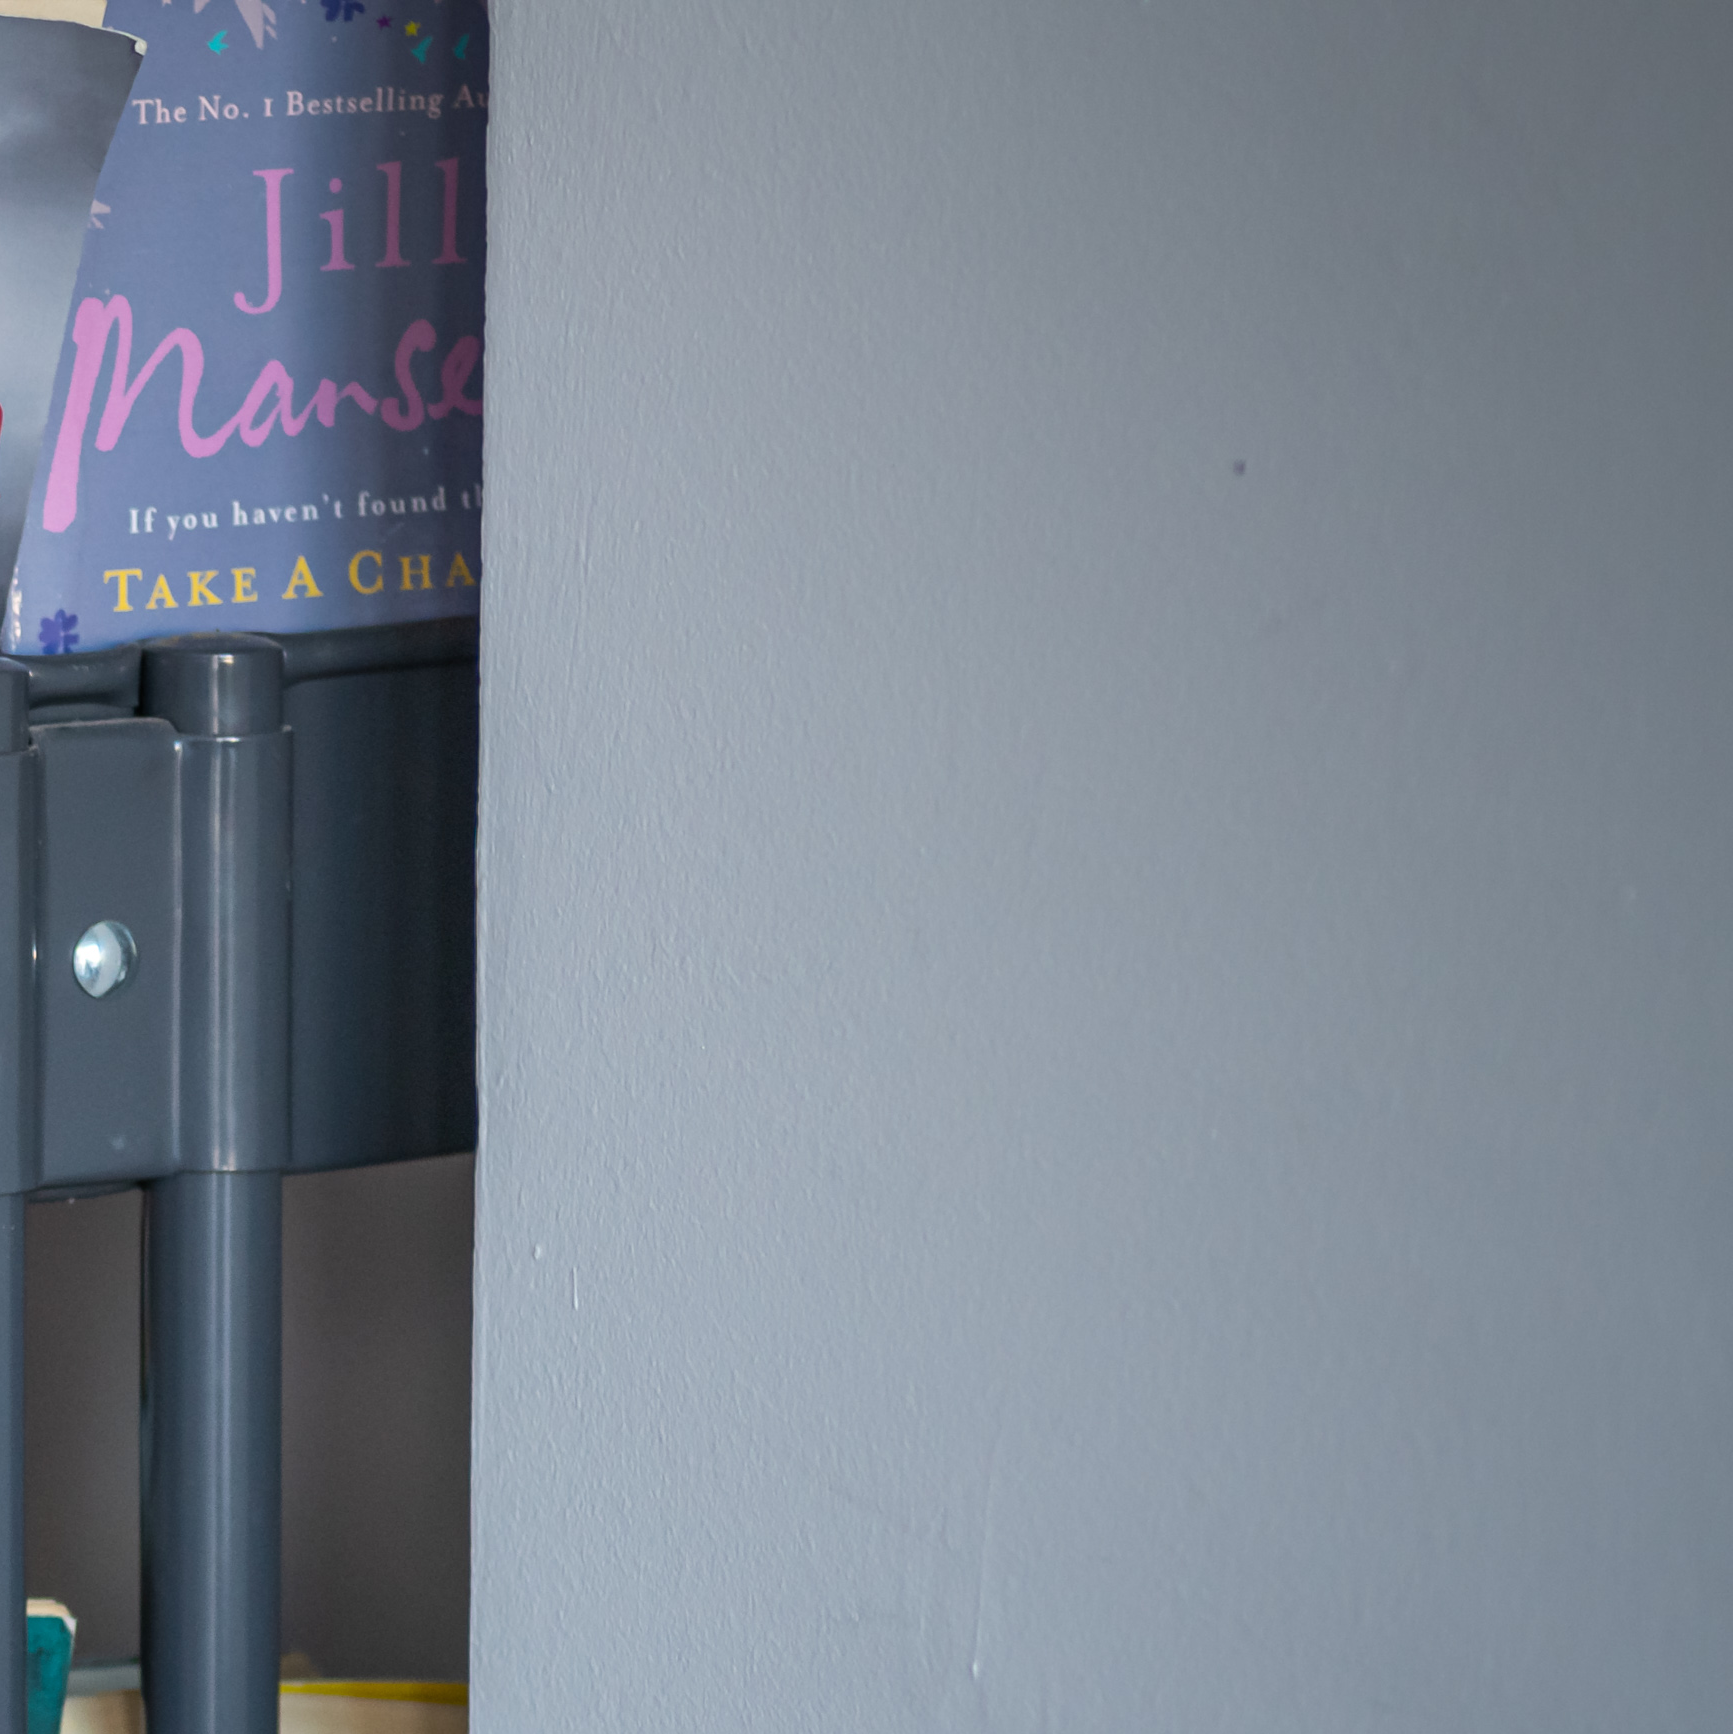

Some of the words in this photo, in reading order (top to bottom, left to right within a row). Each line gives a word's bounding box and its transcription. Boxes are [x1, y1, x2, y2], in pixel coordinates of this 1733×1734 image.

[132, 98, 188, 126] The
[197, 95, 250, 123] No.
[286, 84, 445, 120] Bestselling
[232, 155, 470, 316] Jill
[128, 506, 158, 535] If
[166, 508, 220, 542] you
[358, 485, 448, 518] found
[103, 567, 258, 613] TAKE
[281, 554, 324, 600] A
[347, 549, 478, 596] CHA
